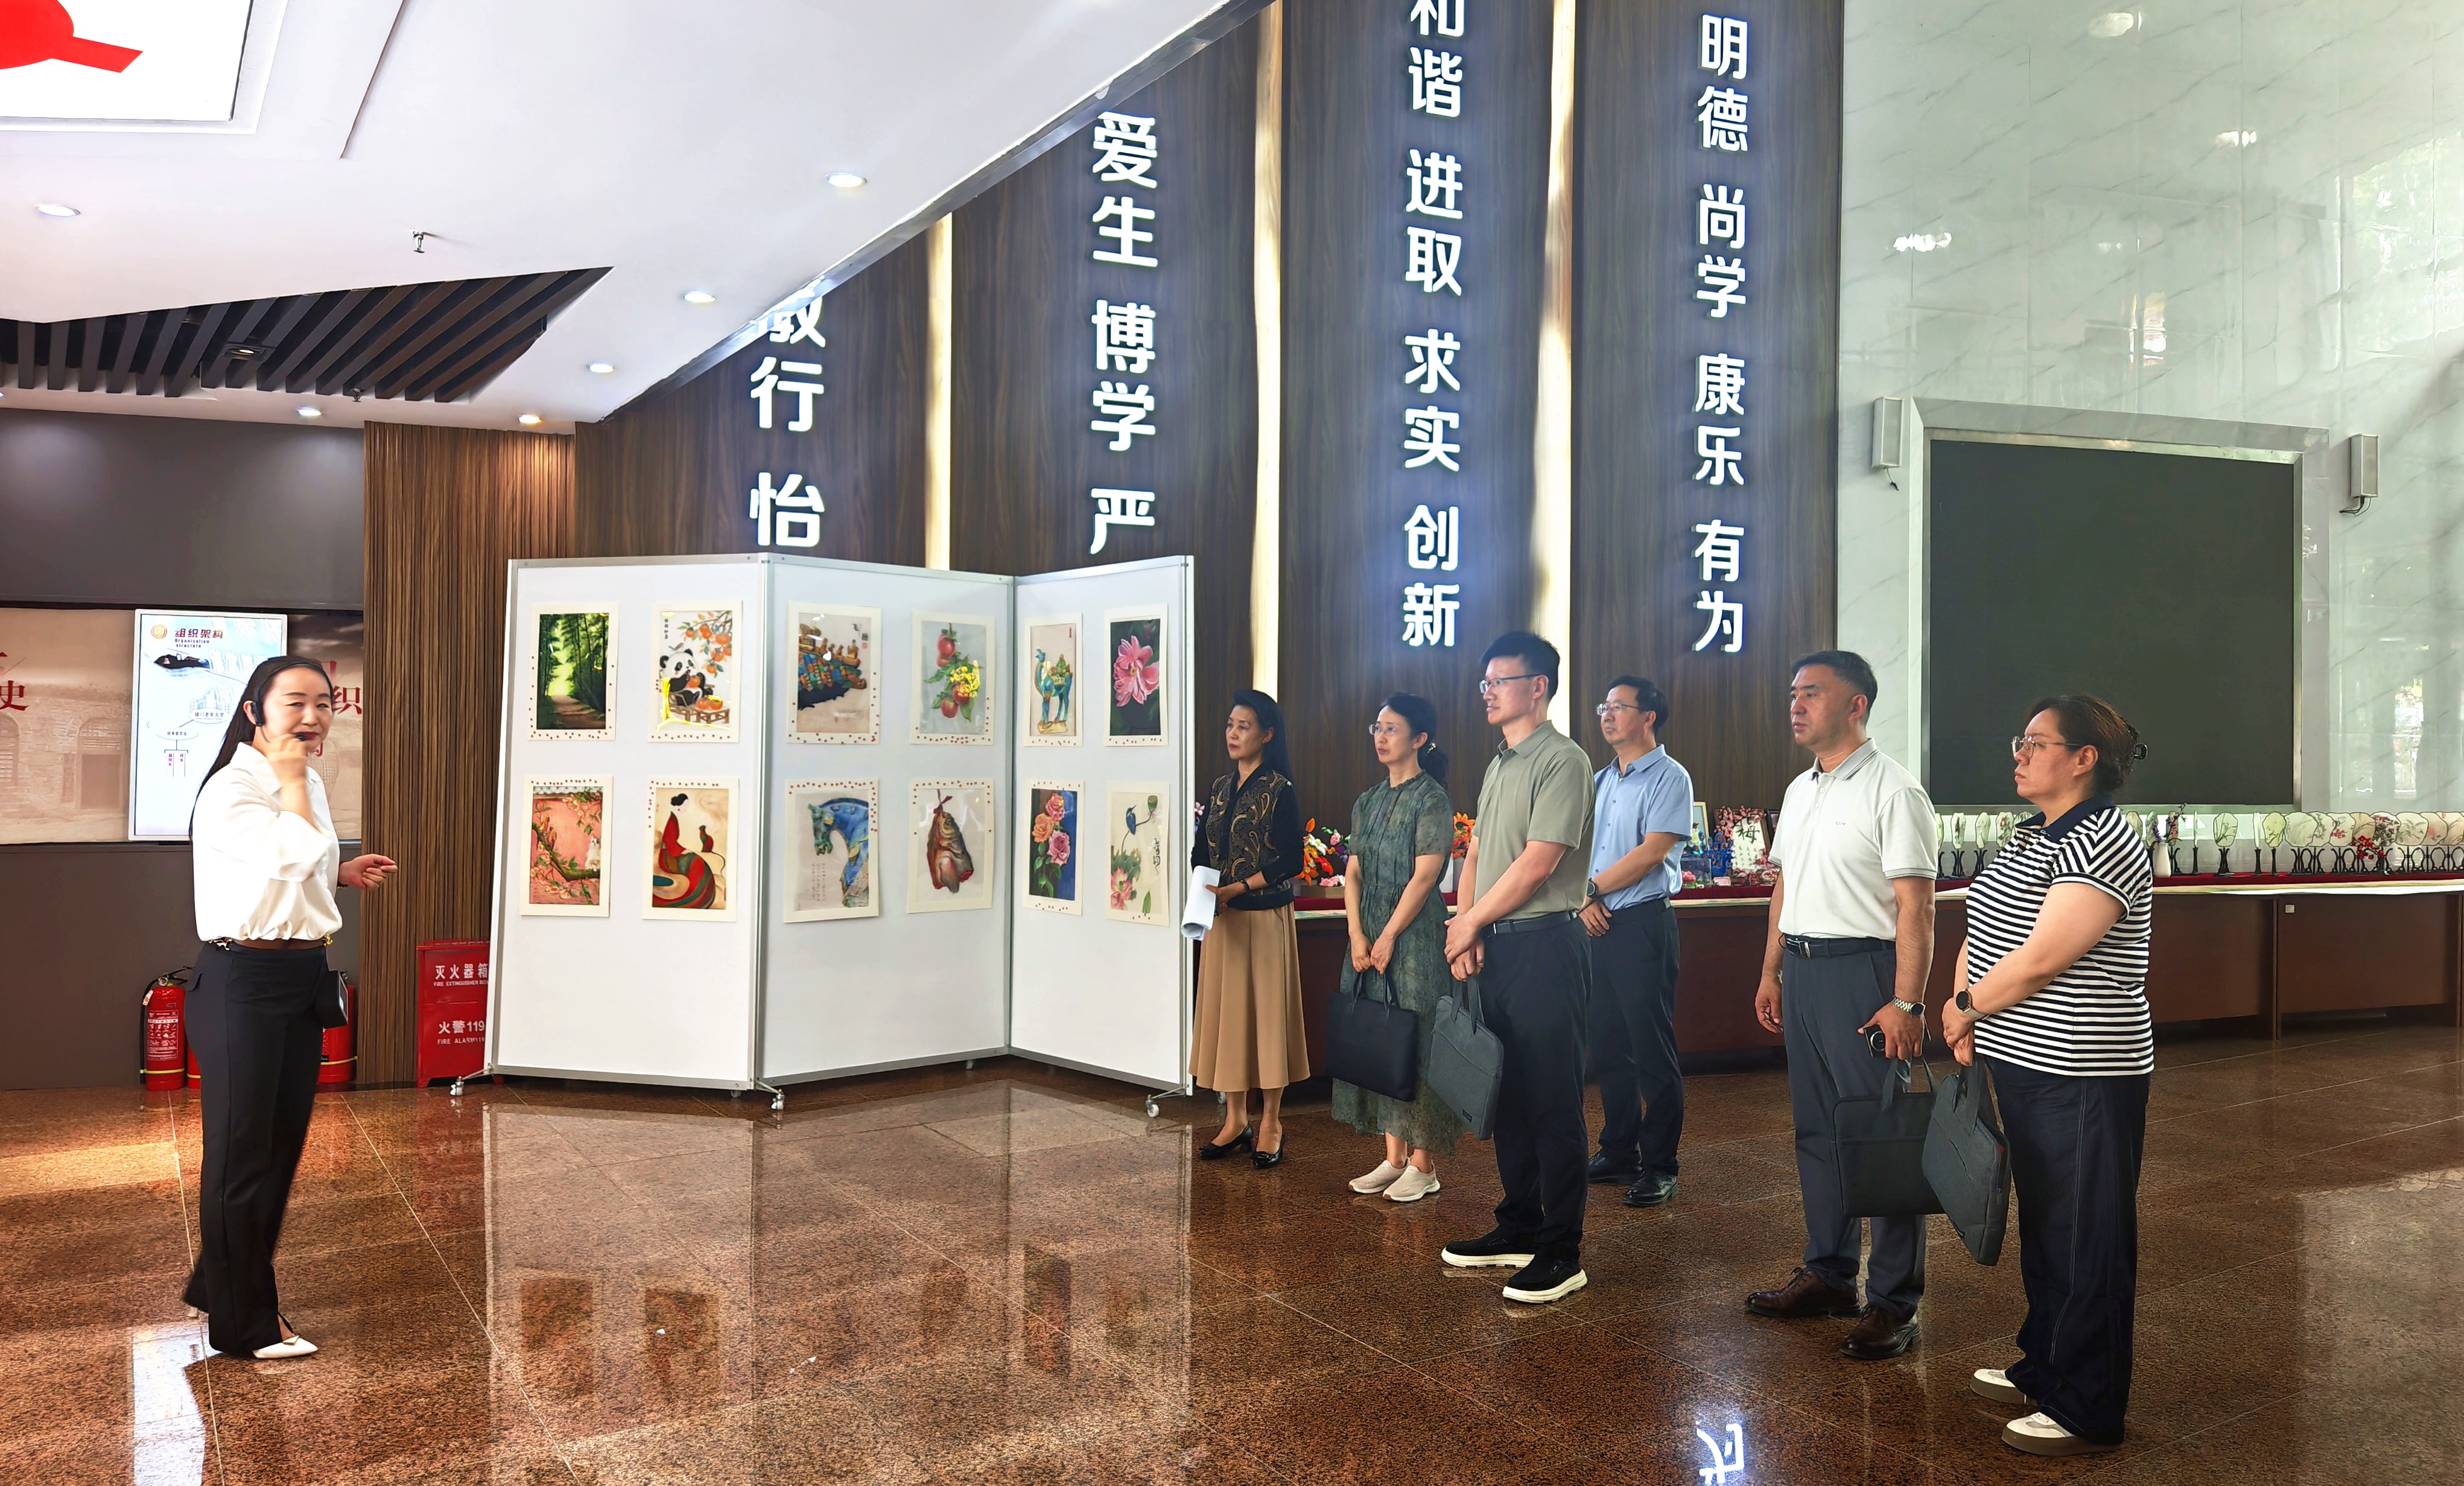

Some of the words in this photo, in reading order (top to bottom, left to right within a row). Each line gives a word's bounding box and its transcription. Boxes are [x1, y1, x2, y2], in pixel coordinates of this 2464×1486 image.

[1408, 0, 1464, 118] 和谐
[1697, 15, 1748, 151] 明德
[1093, 111, 1158, 267] 爱生
[1405, 149, 1463, 296] 进取
[1696, 183, 1747, 318] 尚学
[1091, 299, 1156, 451] 博学
[1403, 329, 1461, 472] 求实
[1695, 353, 1745, 486] 康乐
[749, 472, 825, 547] 怡
[1090, 487, 1155, 554] 严
[1402, 504, 1460, 647] 创新
[175, 628, 223, 638] 组织架构
[1694, 519, 1745, 653] 有为
[435, 962, 488, 980] 灭火器箱
